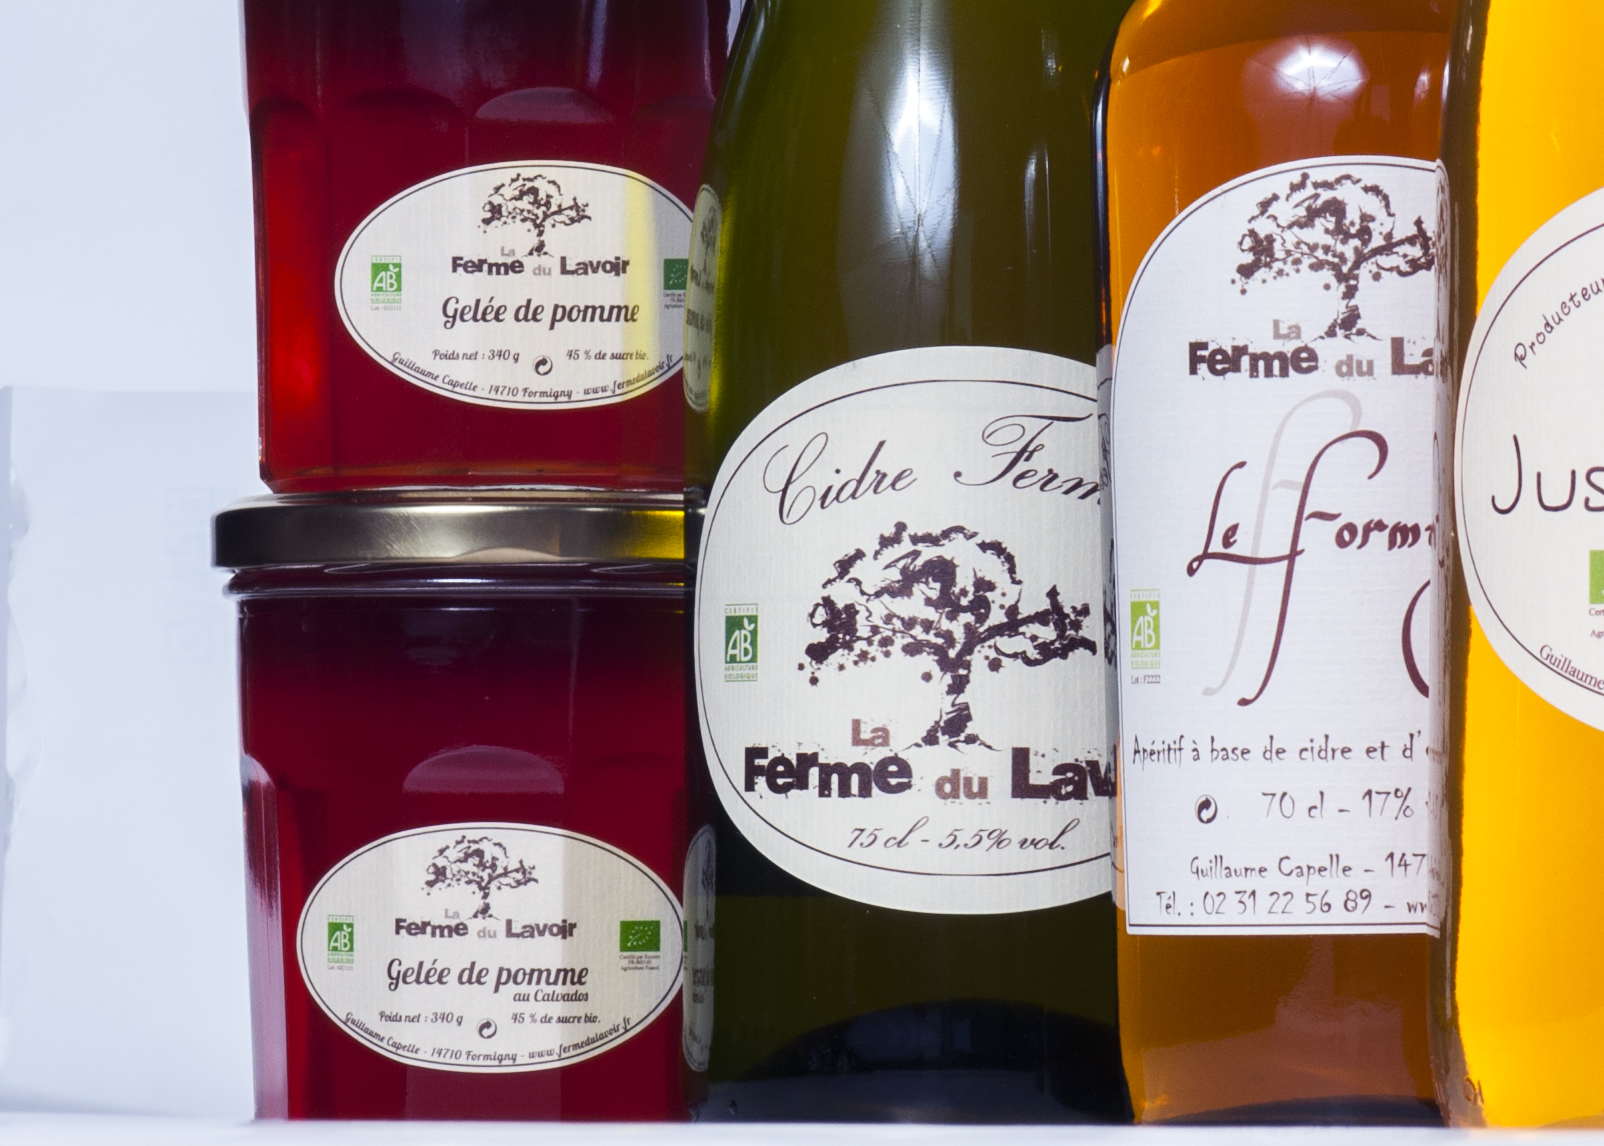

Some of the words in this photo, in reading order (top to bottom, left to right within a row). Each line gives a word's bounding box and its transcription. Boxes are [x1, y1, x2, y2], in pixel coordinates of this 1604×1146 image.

[500, 246, 516, 257] La
[451, 256, 525, 276] Ferme
[532, 264, 552, 276] du
[559, 256, 630, 277] Lavoir
[442, 296, 510, 330] Gelée
[514, 298, 543, 323] de
[549, 304, 640, 331] pomme
[1272, 319, 1302, 340] La
[432, 349, 460, 361] Poids
[461, 350, 479, 361] net
[488, 349, 510, 361] 340
[513, 353, 520, 364] g
[566, 350, 580, 361] 45
[584, 350, 592, 361] %
[594, 350, 608, 361] de
[609, 352, 634, 361] sucre
[1188, 341, 1319, 378] Ferme
[1334, 354, 1375, 378] du
[391, 352, 440, 382] Guillaume
[441, 374, 479, 394] Capelle
[488, 385, 519, 399] 14710
[522, 386, 573, 401] Formigny
[763, 432, 918, 525] Cidre
[851, 719, 890, 747] La
[1132, 734, 1184, 770] Apéritif
[1191, 740, 1201, 762] à
[1210, 735, 1252, 763] base
[1262, 735, 1287, 762] de
[1298, 734, 1352, 762] cidre
[1365, 740, 1391, 762] et
[744, 746, 914, 799] Ferme
[934, 768, 989, 800] du
[1261, 791, 1296, 819] 70
[1307, 791, 1325, 818] cl
[1362, 787, 1415, 821] 17%
[847, 827, 874, 849] 75
[884, 816, 930, 848] cl
[1018, 818, 1081, 851] vol.
[1190, 855, 1268, 880] Guillaume
[1278, 854, 1353, 886] Capelle
[444, 908, 460, 919] La
[1156, 890, 1182, 917] Tél.
[1202, 890, 1227, 916] 02
[1234, 889, 1258, 915] 31
[1267, 890, 1295, 915] 22
[1305, 890, 1332, 916] 56
[1343, 888, 1373, 915] 89
[394, 918, 469, 939] Ferme
[476, 927, 498, 939] du
[505, 919, 577, 940] Lavoir
[387, 958, 451, 992] Gelée
[457, 961, 490, 986] de
[493, 966, 589, 994] pomme
[513, 991, 530, 1003] au
[534, 989, 589, 1003] Calvados
[379, 1010, 402, 1023] Poids
[404, 1012, 421, 1023] net
[431, 1011, 454, 1023] 340
[456, 1015, 463, 1027] g
[511, 1012, 525, 1024] 45
[529, 1012, 537, 1024] %
[540, 1012, 553, 1024] de
[555, 1015, 583, 1024] sucre
[584, 1012, 601, 1024] bio.
[344, 1011, 385, 1043] Guillaume
[386, 1036, 421, 1055] Capelle
[430, 1047, 462, 1061] 14710
[465, 1049, 518, 1064] Formigny
